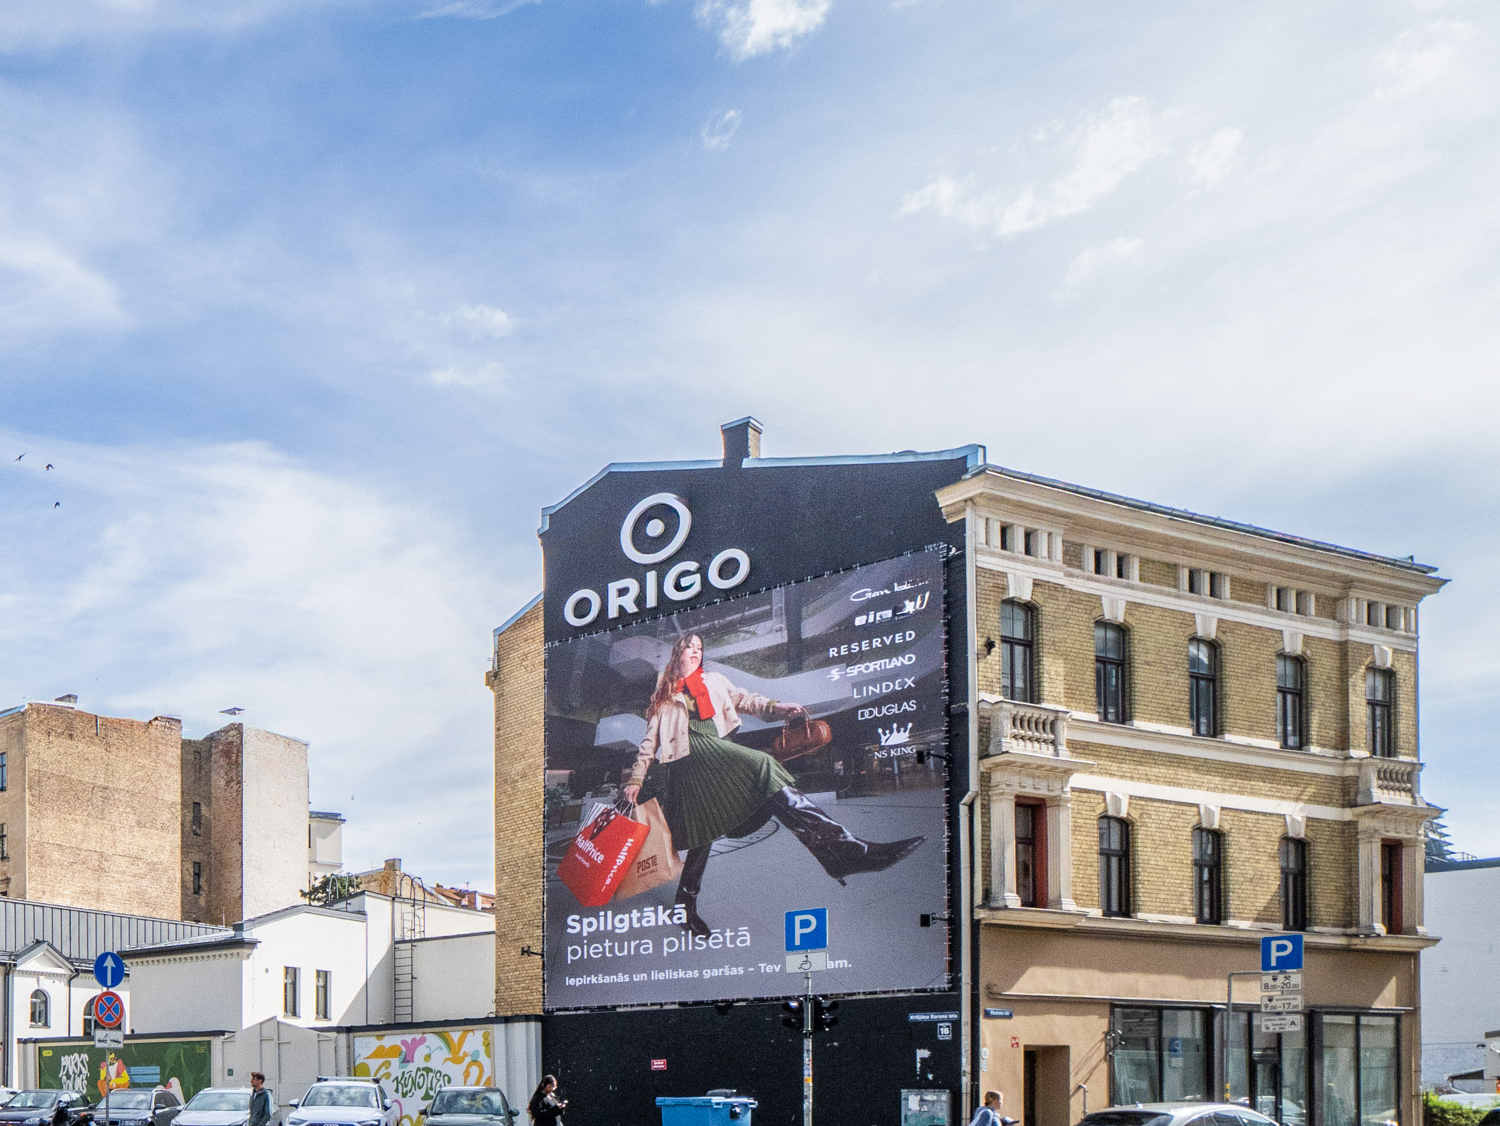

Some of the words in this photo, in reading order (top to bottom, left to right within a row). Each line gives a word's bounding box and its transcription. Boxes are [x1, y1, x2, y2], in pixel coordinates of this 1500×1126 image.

[563, 548, 751, 627] ORIGO
[829, 630, 916, 658] RESERVED
[846, 653, 916, 677] SPORTLAND
[853, 677, 916, 699] LINDEX
[857, 700, 917, 721] DOUGLAS
[874, 749, 888, 760] NS
[890, 745, 916, 758] KING
[575, 834, 605, 864] HalfPrice
[604, 838, 634, 885] HalfPrice
[636, 854, 658, 874] POSTE
[566, 903, 687, 937] Spilgtākā
[794, 914, 817, 946] P
[567, 939, 653, 964] pietura
[663, 926, 751, 957] pilsētā
[1270, 939, 1293, 967] P
[565, 972, 630, 987] Iepirkšanās
[633, 973, 648, 982] un
[651, 966, 699, 981] lieliskas
[702, 965, 744, 979] garšas
[758, 963, 781, 974] Tev
